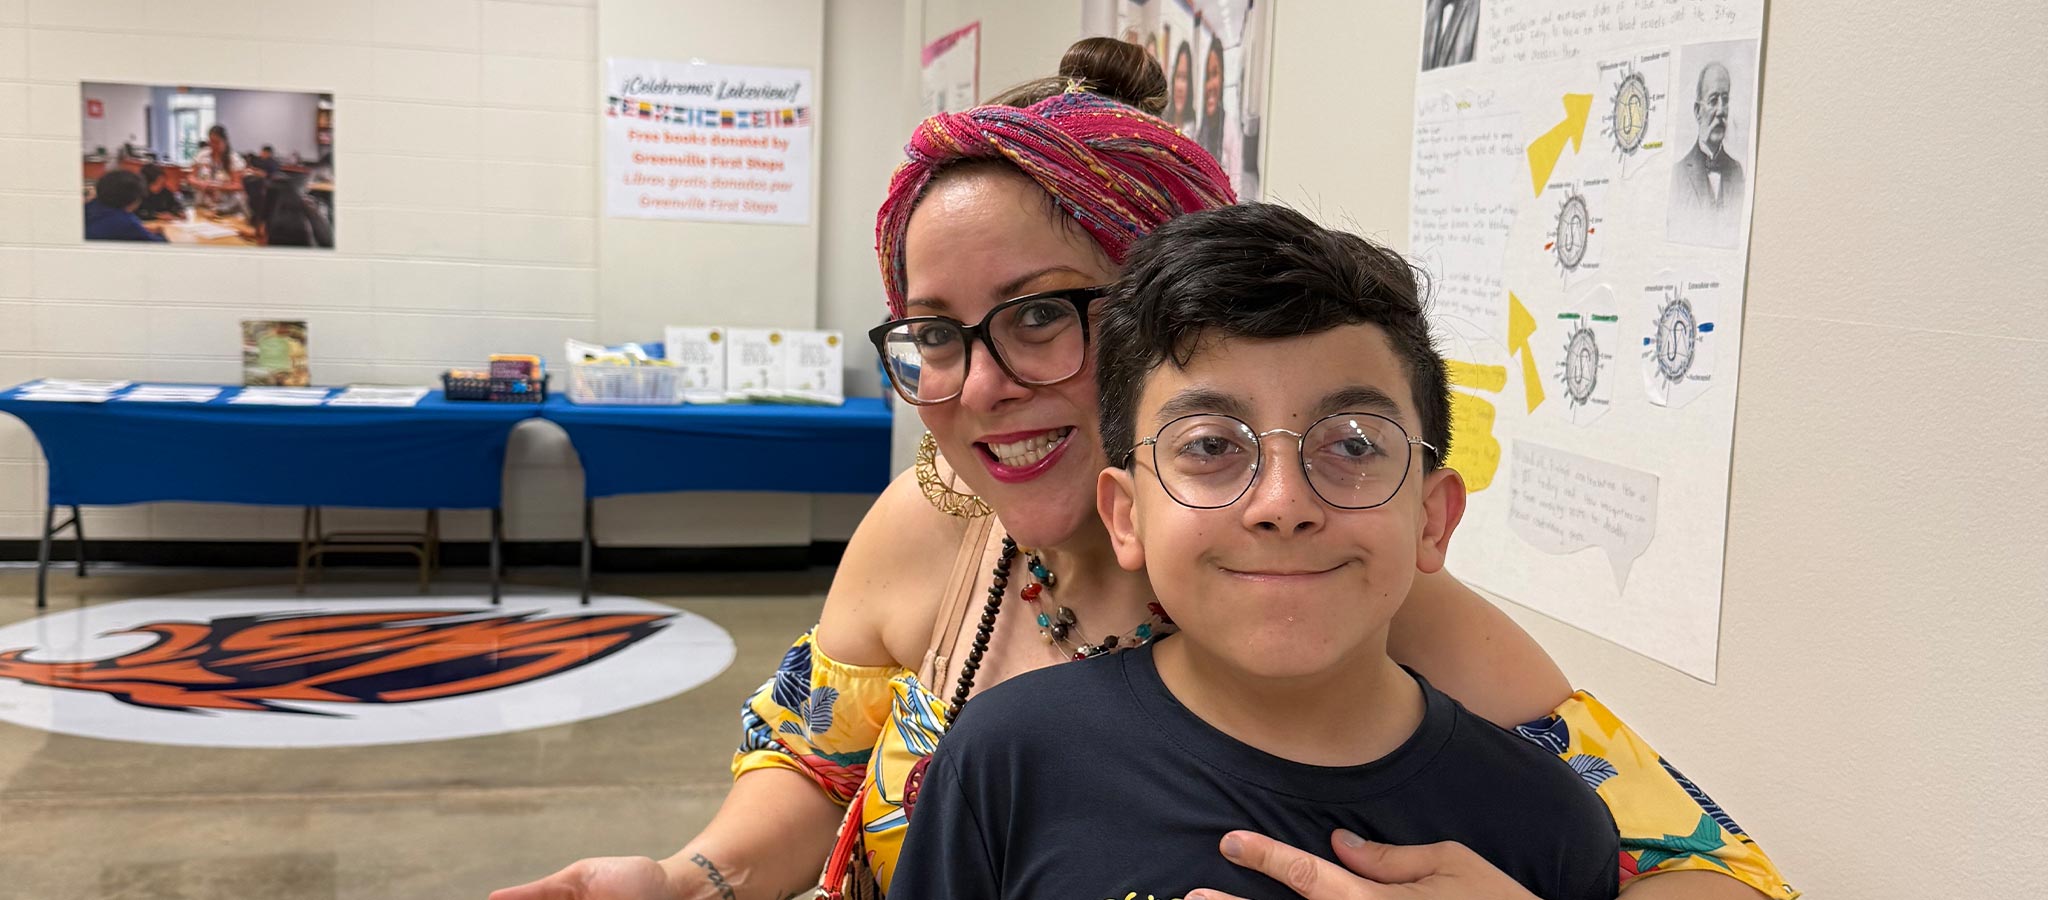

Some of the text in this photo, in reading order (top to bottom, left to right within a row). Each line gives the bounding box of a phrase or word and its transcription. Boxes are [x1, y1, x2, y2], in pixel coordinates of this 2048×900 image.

[628, 130, 790, 152] Free books donated by
[633, 152, 785, 172] Greenville First Steps
[640, 195, 705, 209] Greenville
